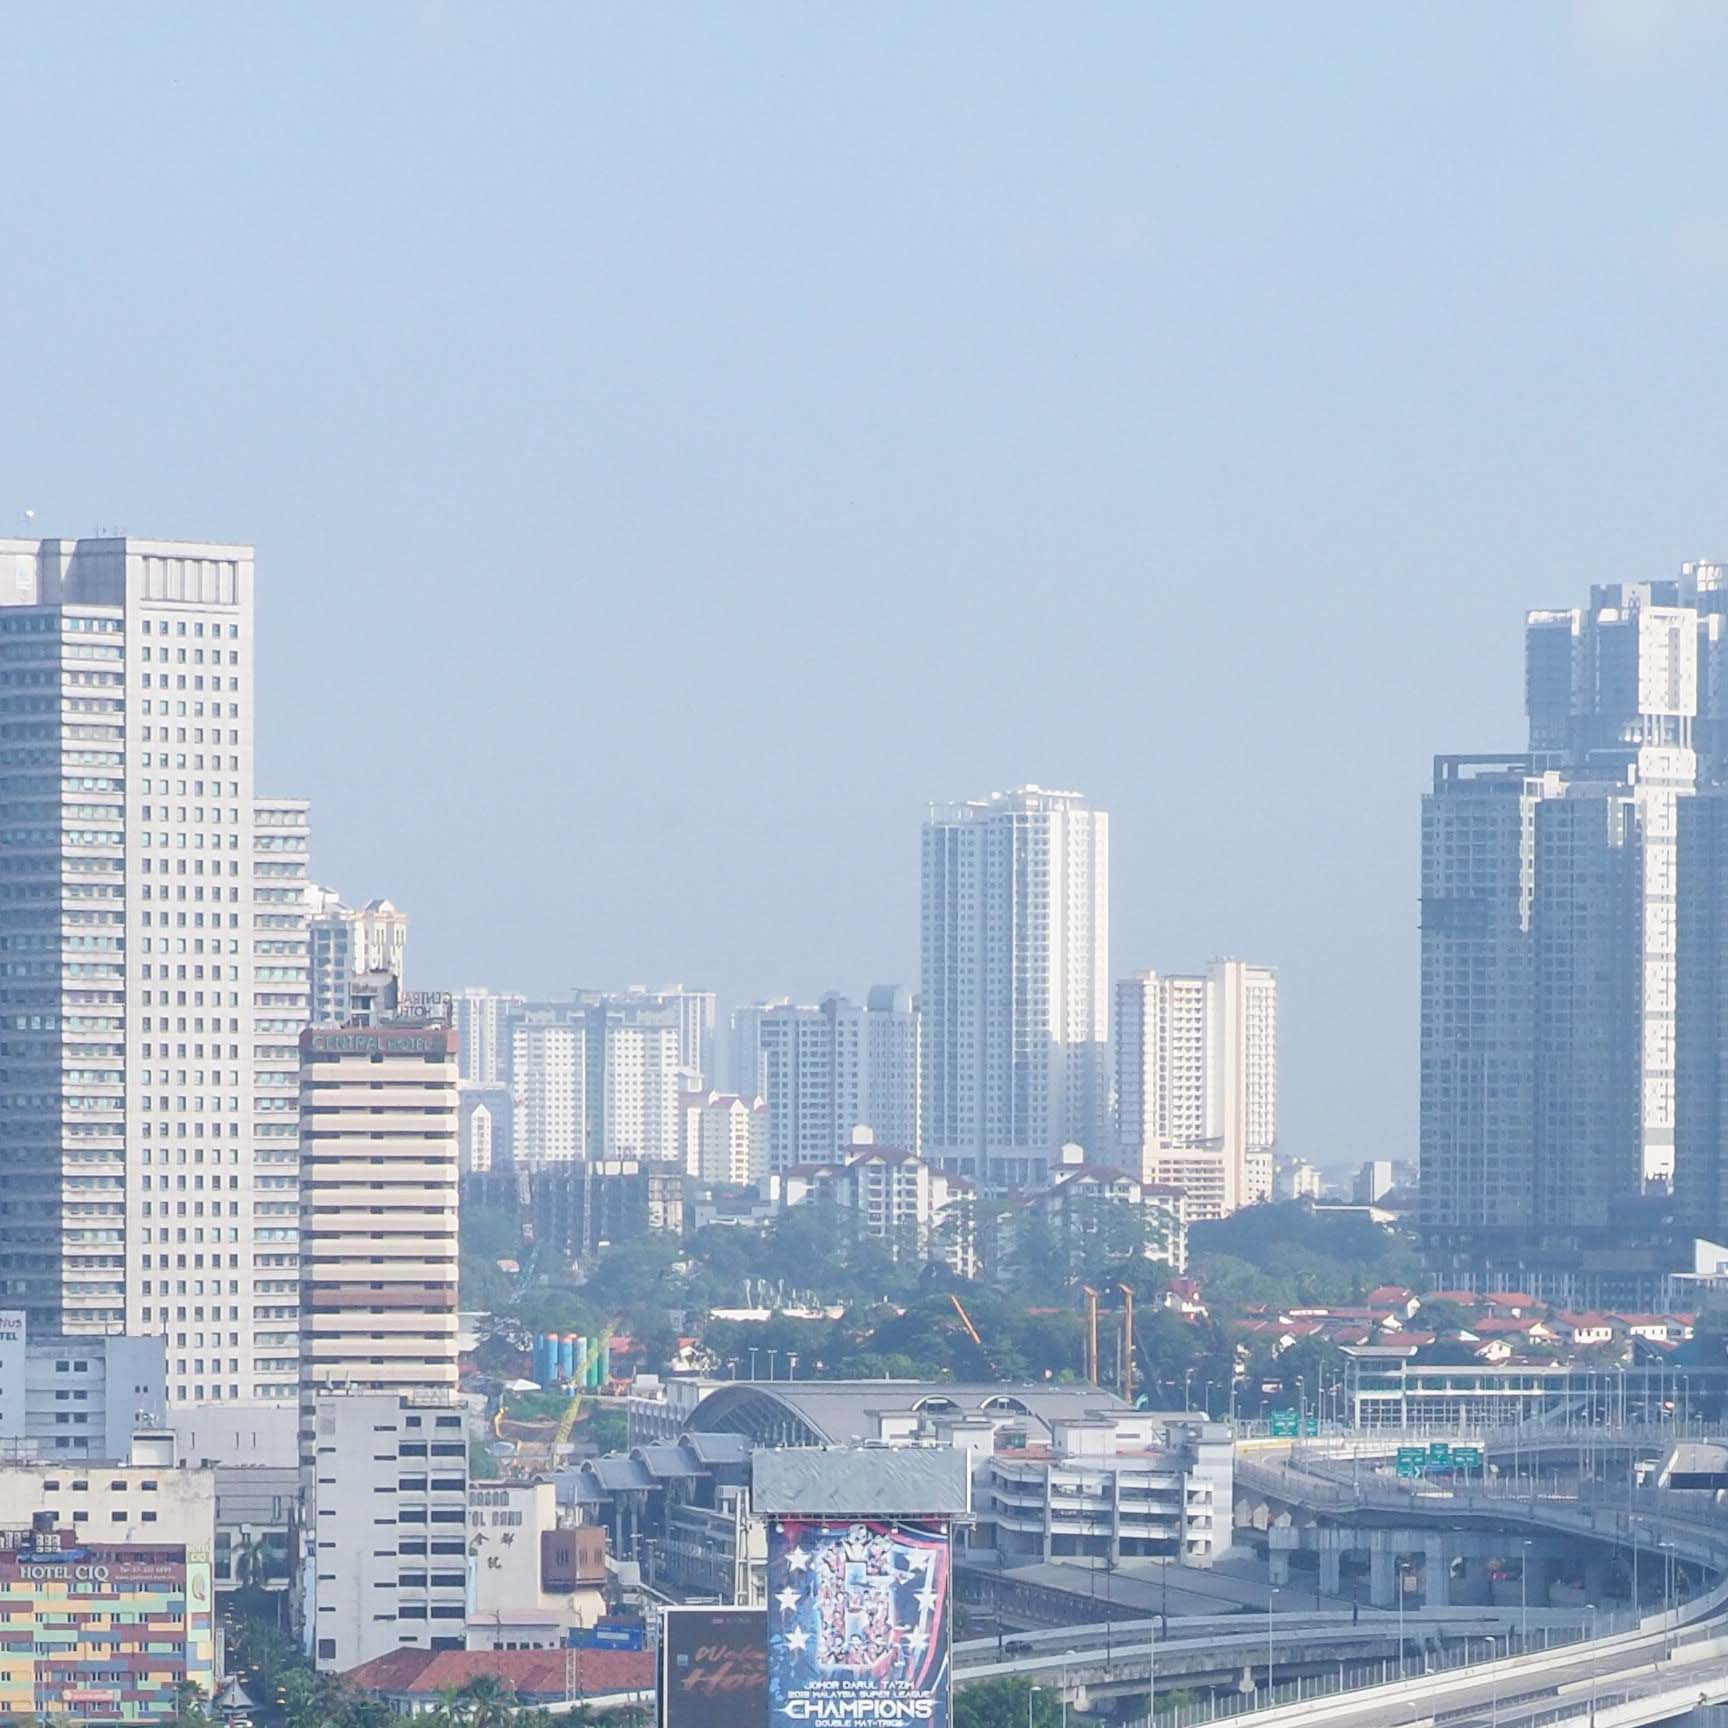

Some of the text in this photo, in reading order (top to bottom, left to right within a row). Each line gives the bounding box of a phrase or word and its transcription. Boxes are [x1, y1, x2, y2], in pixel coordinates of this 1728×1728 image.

[312, 1035, 385, 1050] CENTRAL
[20, 1566, 72, 1580] HOTEL
[75, 1566, 109, 1582] CIQ
[804, 1681, 839, 1690] JOHOR
[842, 1681, 878, 1690] DARUL
[782, 1699, 933, 1719] CHAMPIONS
[815, 1720, 851, 1728] DOUBLE
